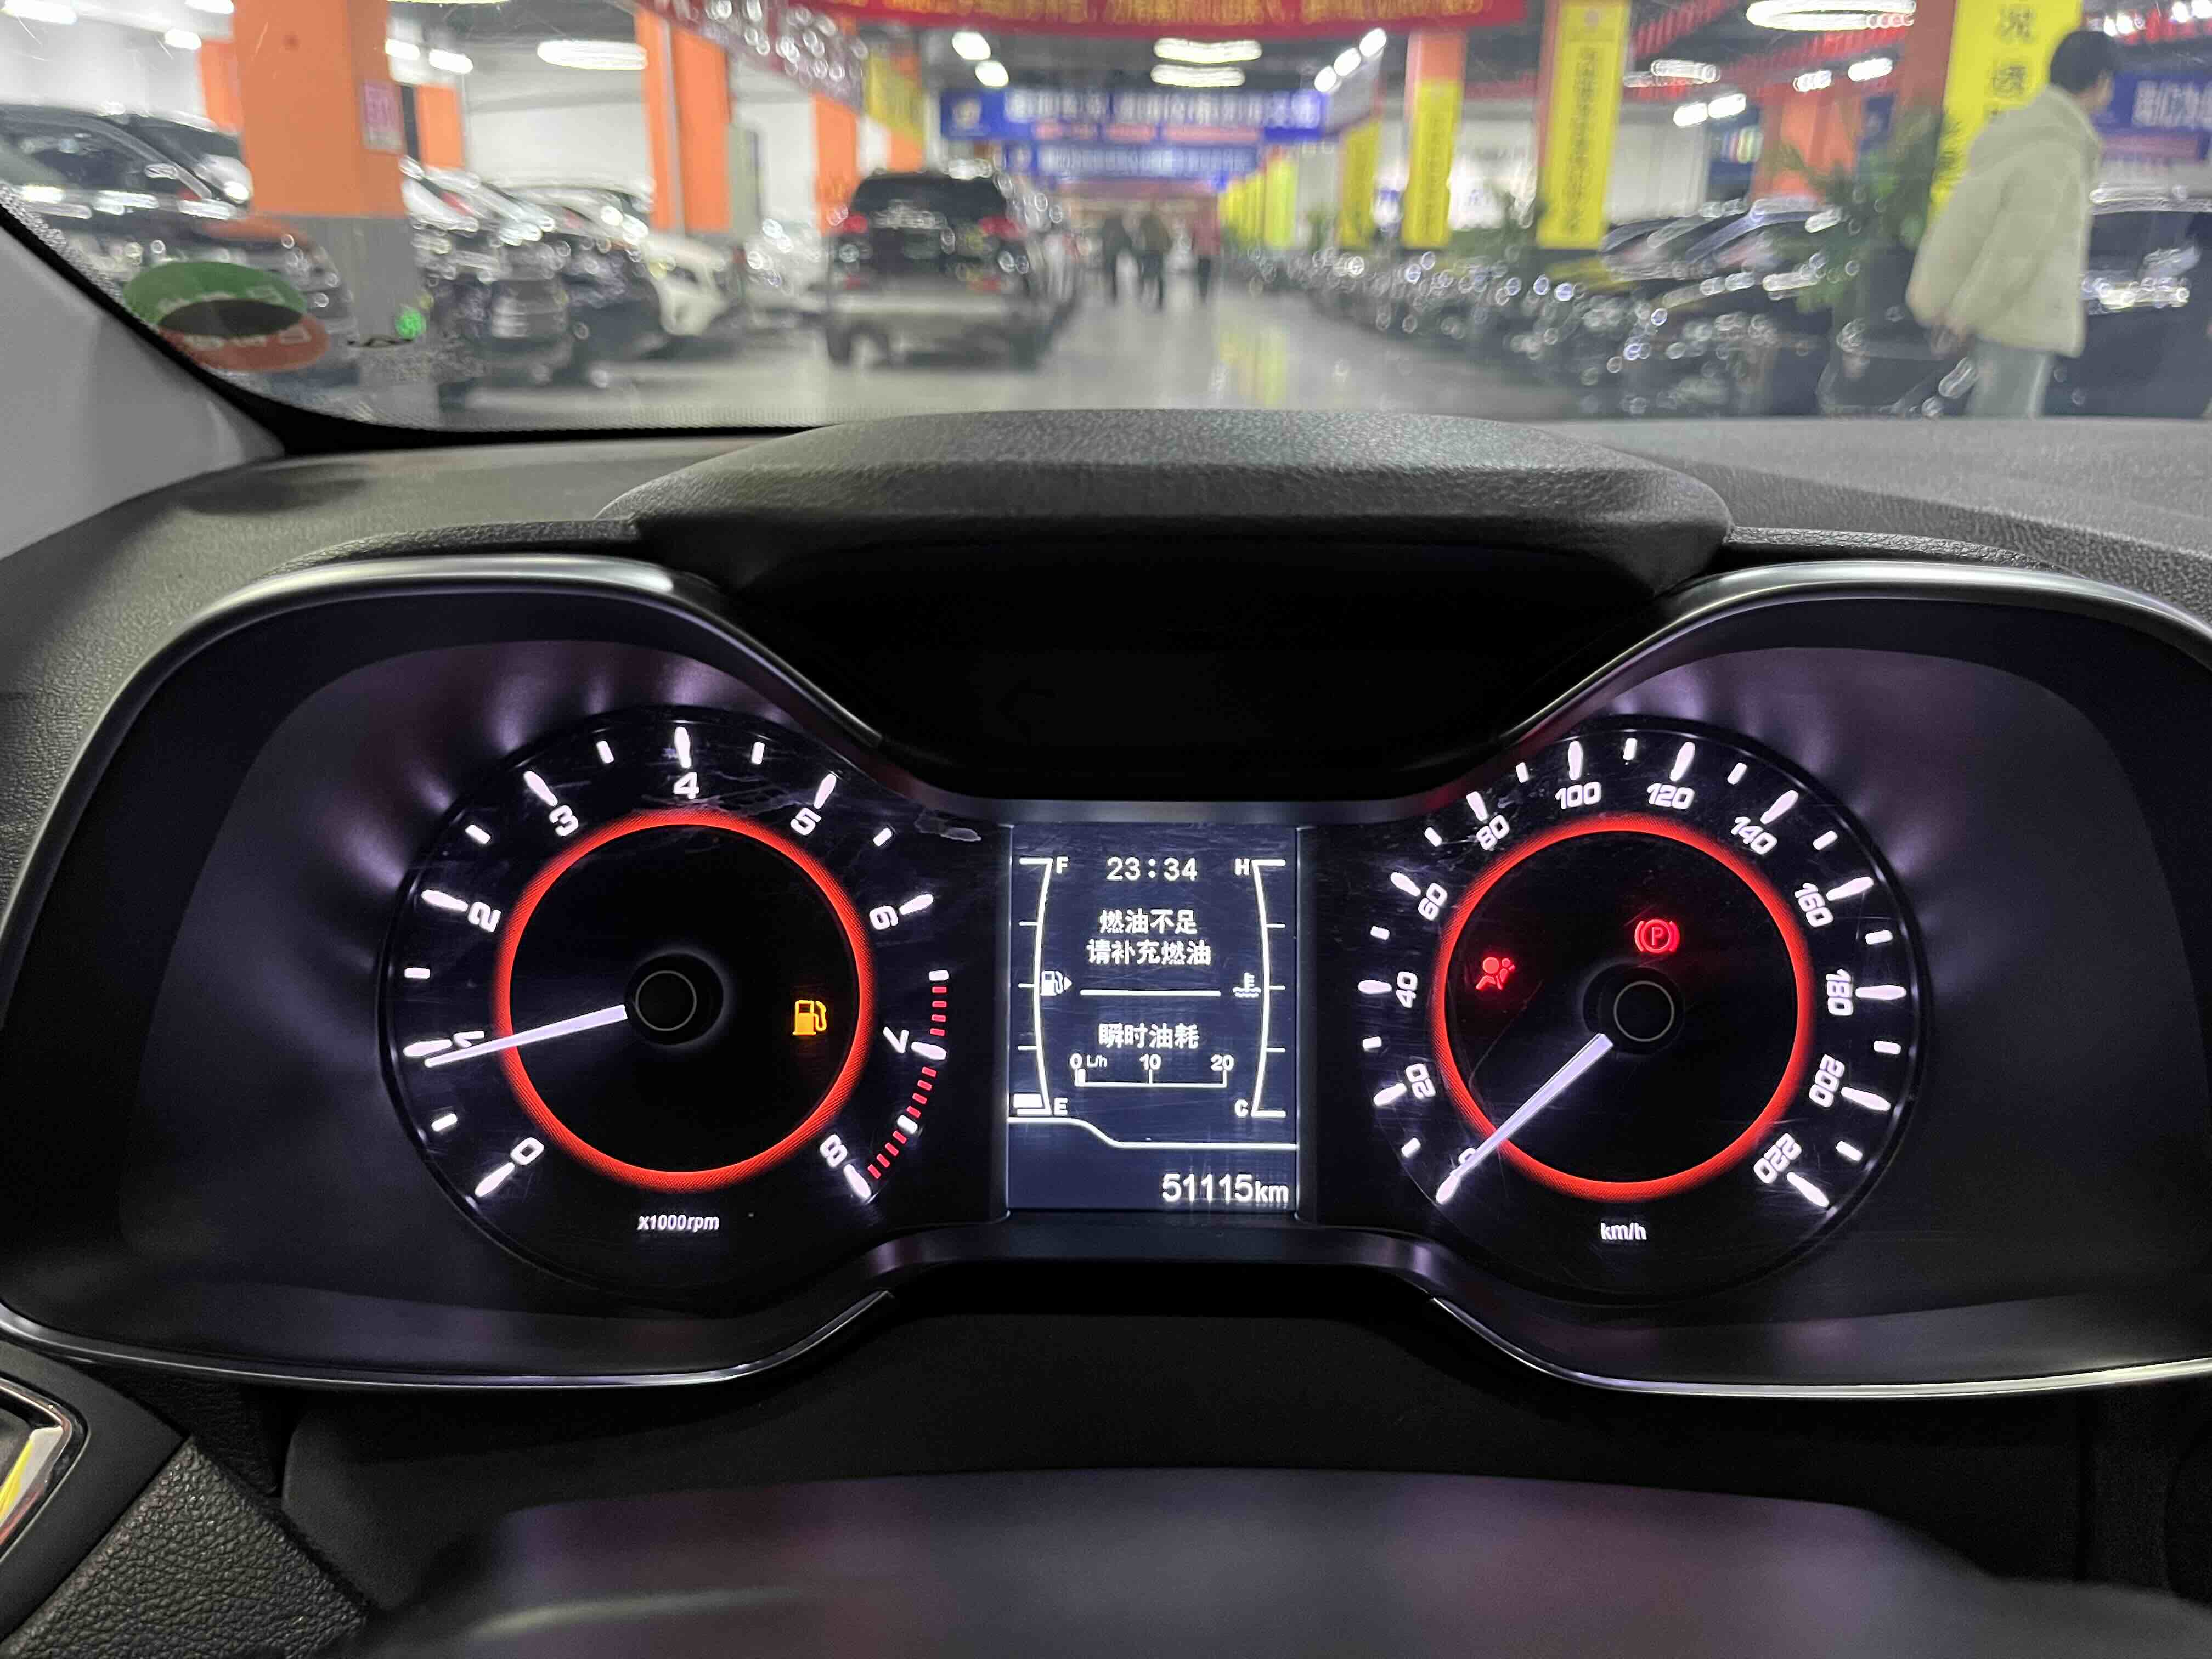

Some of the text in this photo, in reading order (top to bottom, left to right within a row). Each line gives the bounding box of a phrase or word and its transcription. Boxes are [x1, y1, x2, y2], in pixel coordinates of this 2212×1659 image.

[673, 772, 699, 799] 4
[1555, 781, 1602, 809] 100
[1647, 782, 1695, 810] 120
[549, 805, 579, 837] 3
[790, 807, 821, 836] 5
[1476, 815, 1510, 851] 80
[1730, 816, 1778, 855] 140
[1056, 856, 1069, 875] F
[1107, 856, 1198, 882] 23:34
[1234, 857, 1250, 876] H
[1418, 883, 1448, 921] 60
[1794, 882, 1833, 927] 160
[470, 901, 501, 933] 2
[869, 905, 899, 930] 6
[1099, 908, 1198, 935] 燃油不足
[1086, 938, 1211, 966] 请补充燃油
[1396, 971, 1418, 1008] 40
[1825, 969, 1854, 1016] 180
[453, 1031, 485, 1048] 1
[883, 1026, 909, 1054] 7
[1098, 1022, 1200, 1049] 瞬时油耗
[1069, 1053, 1083, 1070] 0
[1139, 1053, 1162, 1071] 10
[1210, 1053, 1235, 1071] 20
[1405, 1063, 1436, 1100] 20
[1809, 1054, 1845, 1107] 200
[1053, 1097, 1068, 1116] E
[1234, 1098, 1249, 1117] C
[510, 1137, 544, 1166] 0
[820, 1134, 848, 1168] 8
[1753, 1133, 1802, 1184] 220
[1162, 1172, 1289, 1203] 51115km
[637, 1214, 720, 1233] x1000rpm
[1600, 1222, 1647, 1240] km/h
